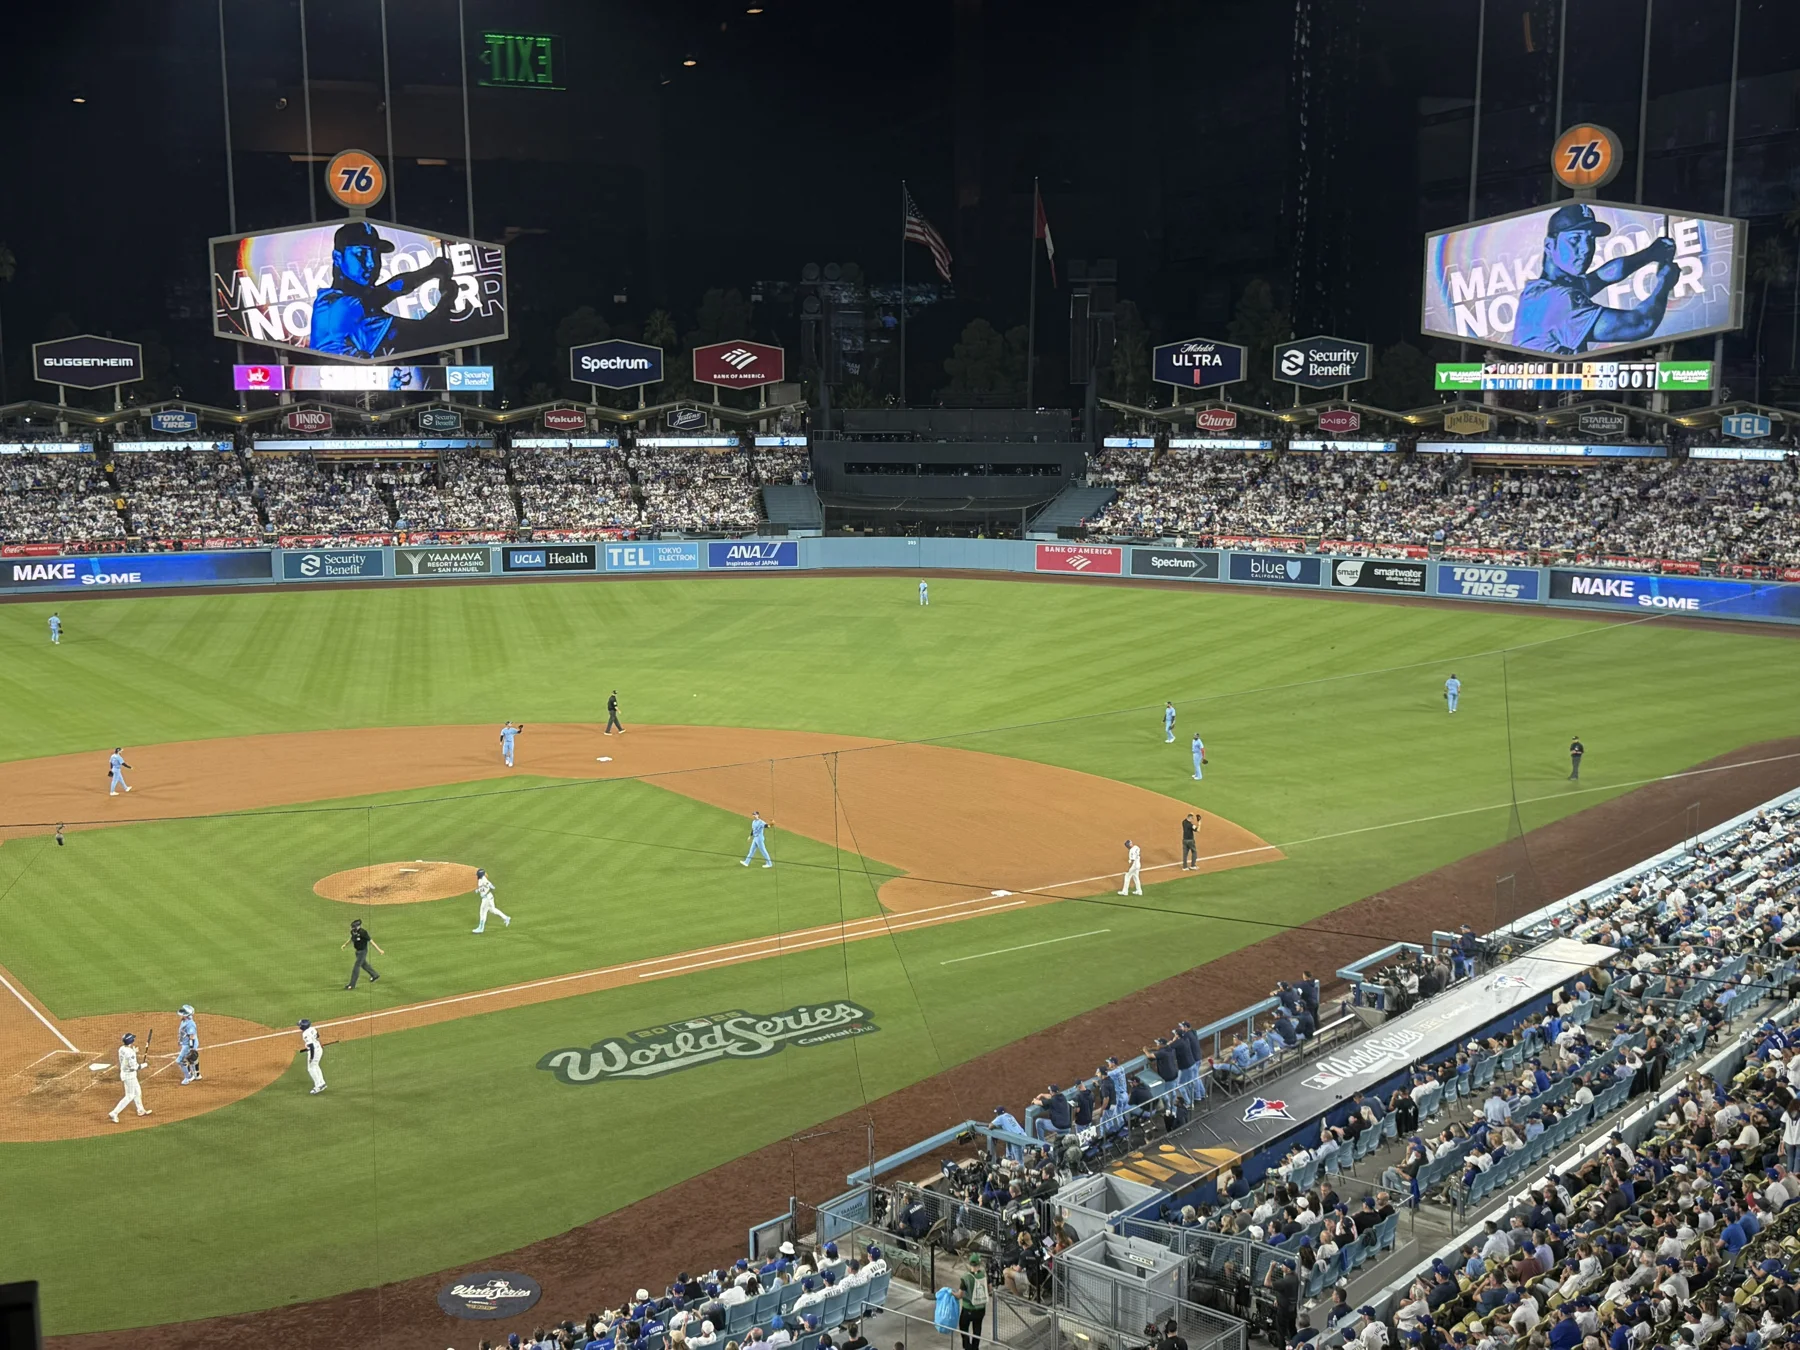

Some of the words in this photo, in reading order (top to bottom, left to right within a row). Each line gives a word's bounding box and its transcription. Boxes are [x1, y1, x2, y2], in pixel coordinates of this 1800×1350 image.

[1564, 140, 1603, 172] 76
[338, 165, 375, 193] 76
[239, 264, 334, 307] MAK
[1450, 254, 1542, 304] MAK
[43, 358, 134, 367] GUGGENHEIM
[581, 356, 648, 372] Spectrum
[1172, 353, 1223, 367] ULTRA
[1308, 349, 1359, 365] Security
[464, 371, 490, 380] Security
[1308, 363, 1352, 376] Benefit
[1587, 365, 1591, 373] 2
[1599, 365, 1604, 373] 4
[1610, 365, 1615, 373] 0
[1599, 380, 1603, 388] 2
[1609, 380, 1614, 388] 0
[1618, 371, 1629, 388] 0
[1632, 371, 1642, 388] 0
[1646, 371, 1654, 388] 1
[295, 413, 325, 427] JINRO
[434, 414, 457, 422] Security
[547, 415, 584, 424] Yakult
[1198, 414, 1234, 426] Churu
[1463, 413, 1485, 428] BEAM
[1581, 416, 1623, 425] STARLUX
[1728, 417, 1764, 434] TEL
[515, 555, 541, 564] UCLA
[549, 553, 588, 564] Health
[609, 548, 650, 566] TEL
[726, 546, 760, 558] ANA
[324, 554, 366, 566] Security
[1151, 556, 1195, 569] Spectrum
[1251, 559, 1284, 574] blue
[13, 563, 76, 581] MAKE
[81, 572, 142, 585] SOME
[325, 565, 360, 575] Benefit
[1374, 568, 1422, 577] smartwater
[1453, 567, 1507, 583] TOYO
[1460, 582, 1519, 598] TIRES
[1571, 577, 1634, 597] MAKE
[1638, 595, 1699, 610] SOME
[548, 1025, 735, 1081] World
[722, 1003, 864, 1057] Series
[798, 1029, 850, 1044] Capital
[1316, 1043, 1387, 1078] World
[1371, 1029, 1424, 1060] Series
[451, 1284, 495, 1298] World
[486, 1285, 532, 1300] Series
